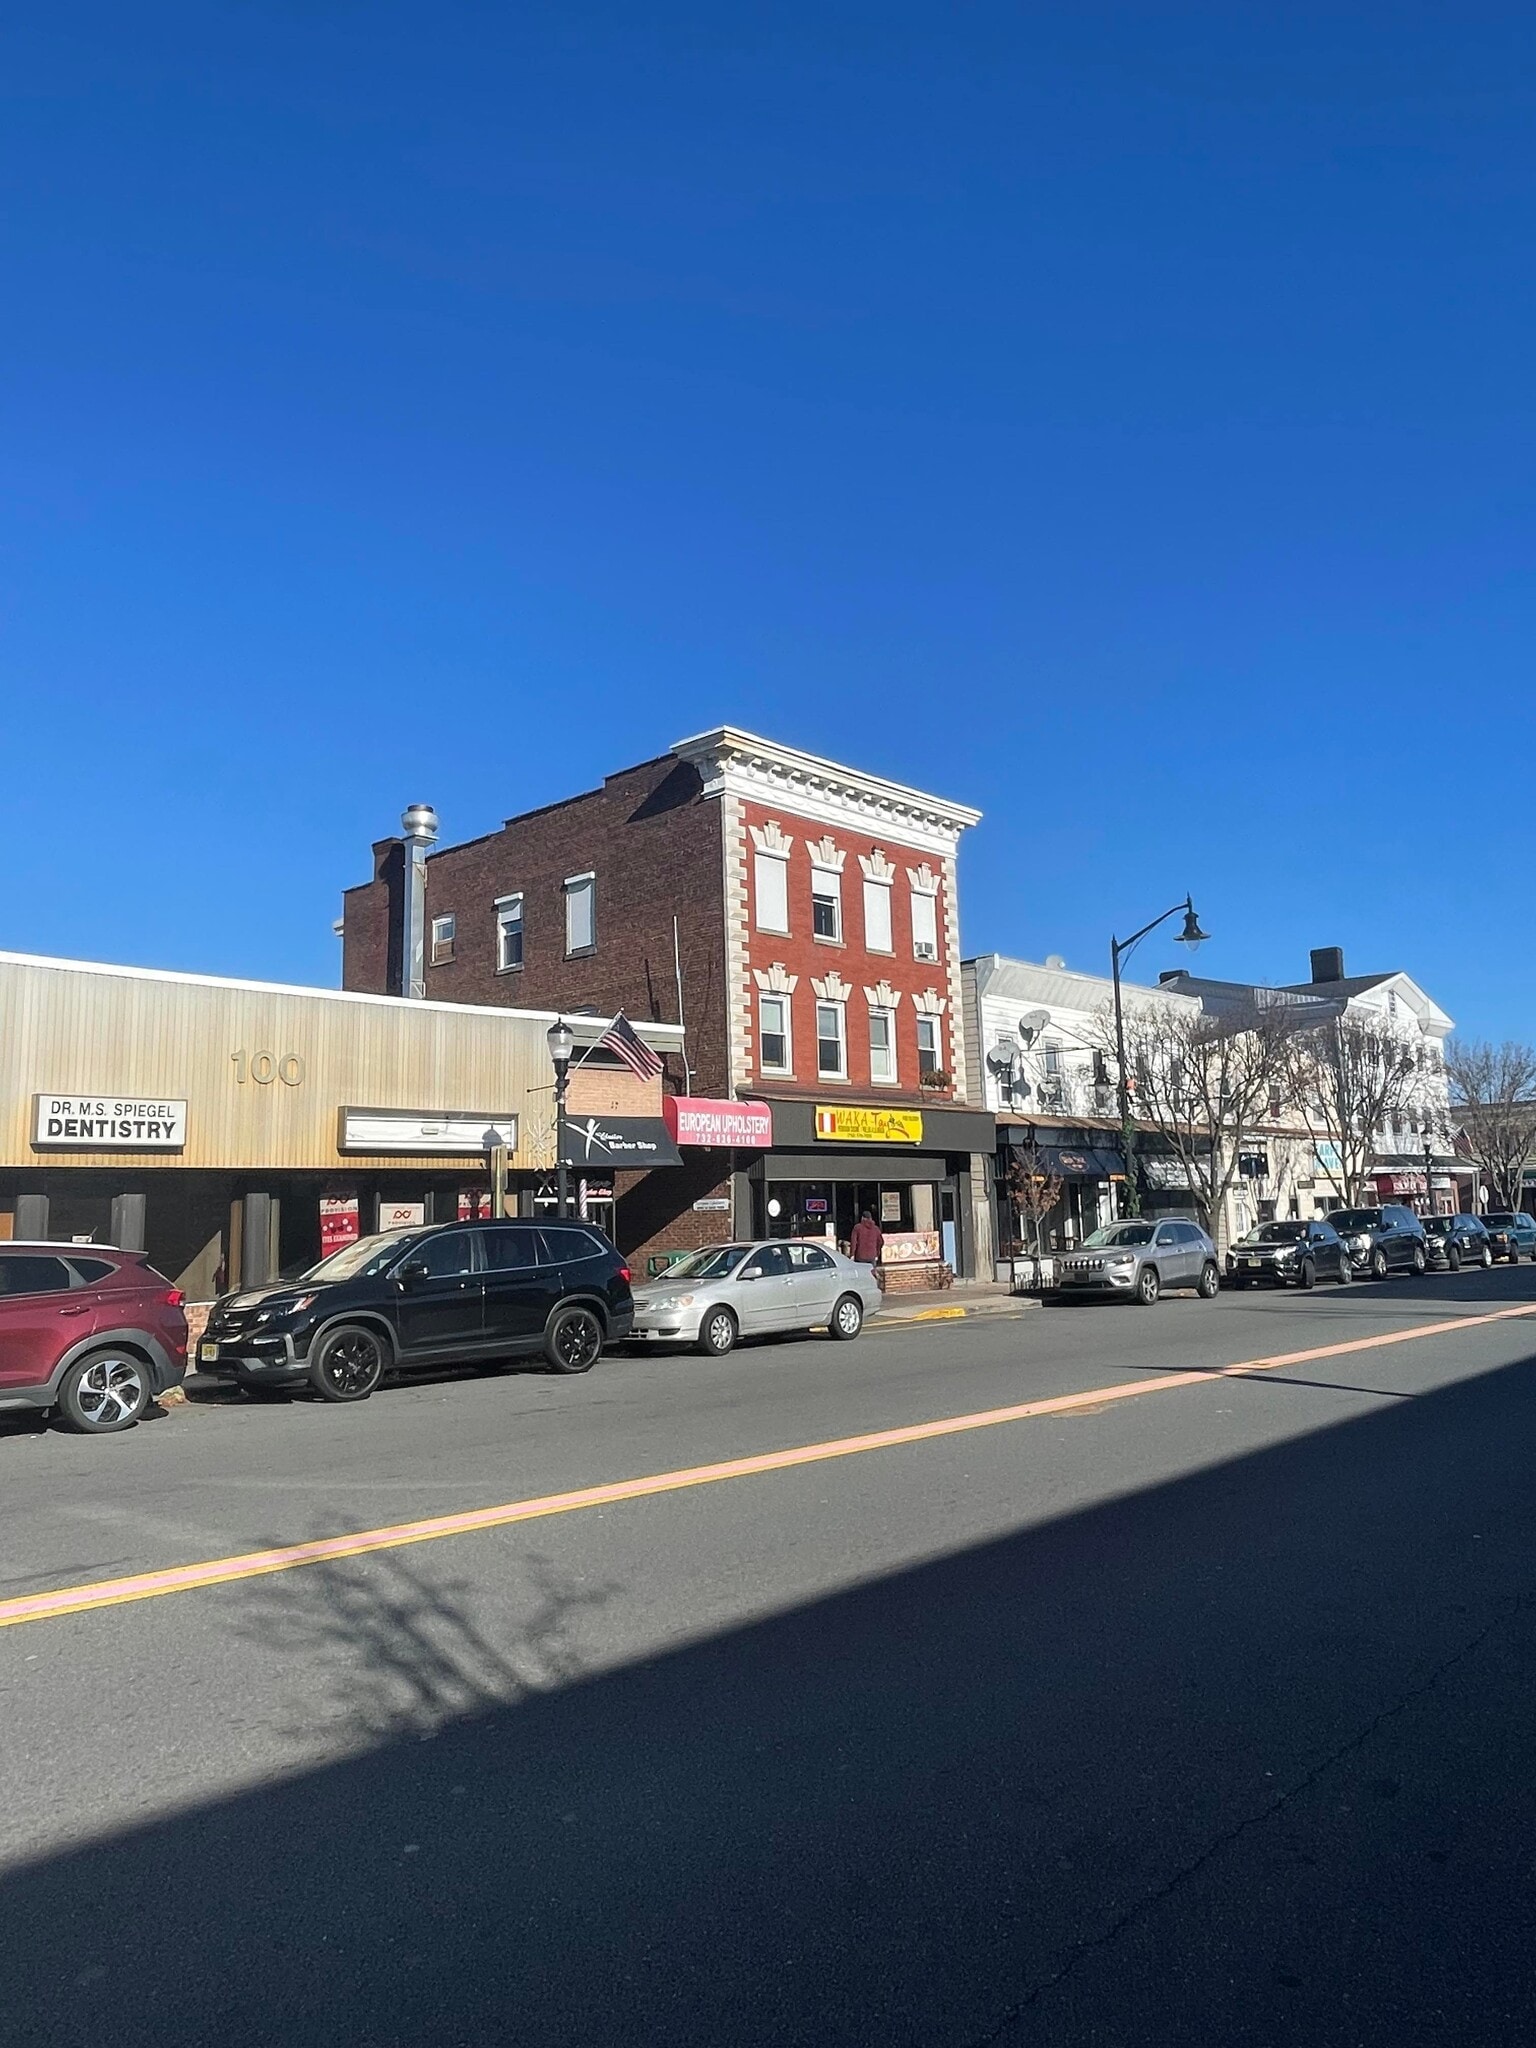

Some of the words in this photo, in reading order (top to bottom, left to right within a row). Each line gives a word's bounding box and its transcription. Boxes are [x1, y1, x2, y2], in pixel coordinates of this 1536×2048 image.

[230, 1049, 306, 1087] 100
[51, 1101, 75, 1115] DR.
[79, 1102, 107, 1116] M.S.
[114, 1103, 175, 1118] SPIEGEL
[47, 1119, 176, 1139] DENTISTRY
[679, 1112, 721, 1133] EUROPEAN
[722, 1114, 769, 1134] UPHOLSTERY
[608, 1141, 636, 1150] Barber
[636, 1141, 657, 1151] Shop
